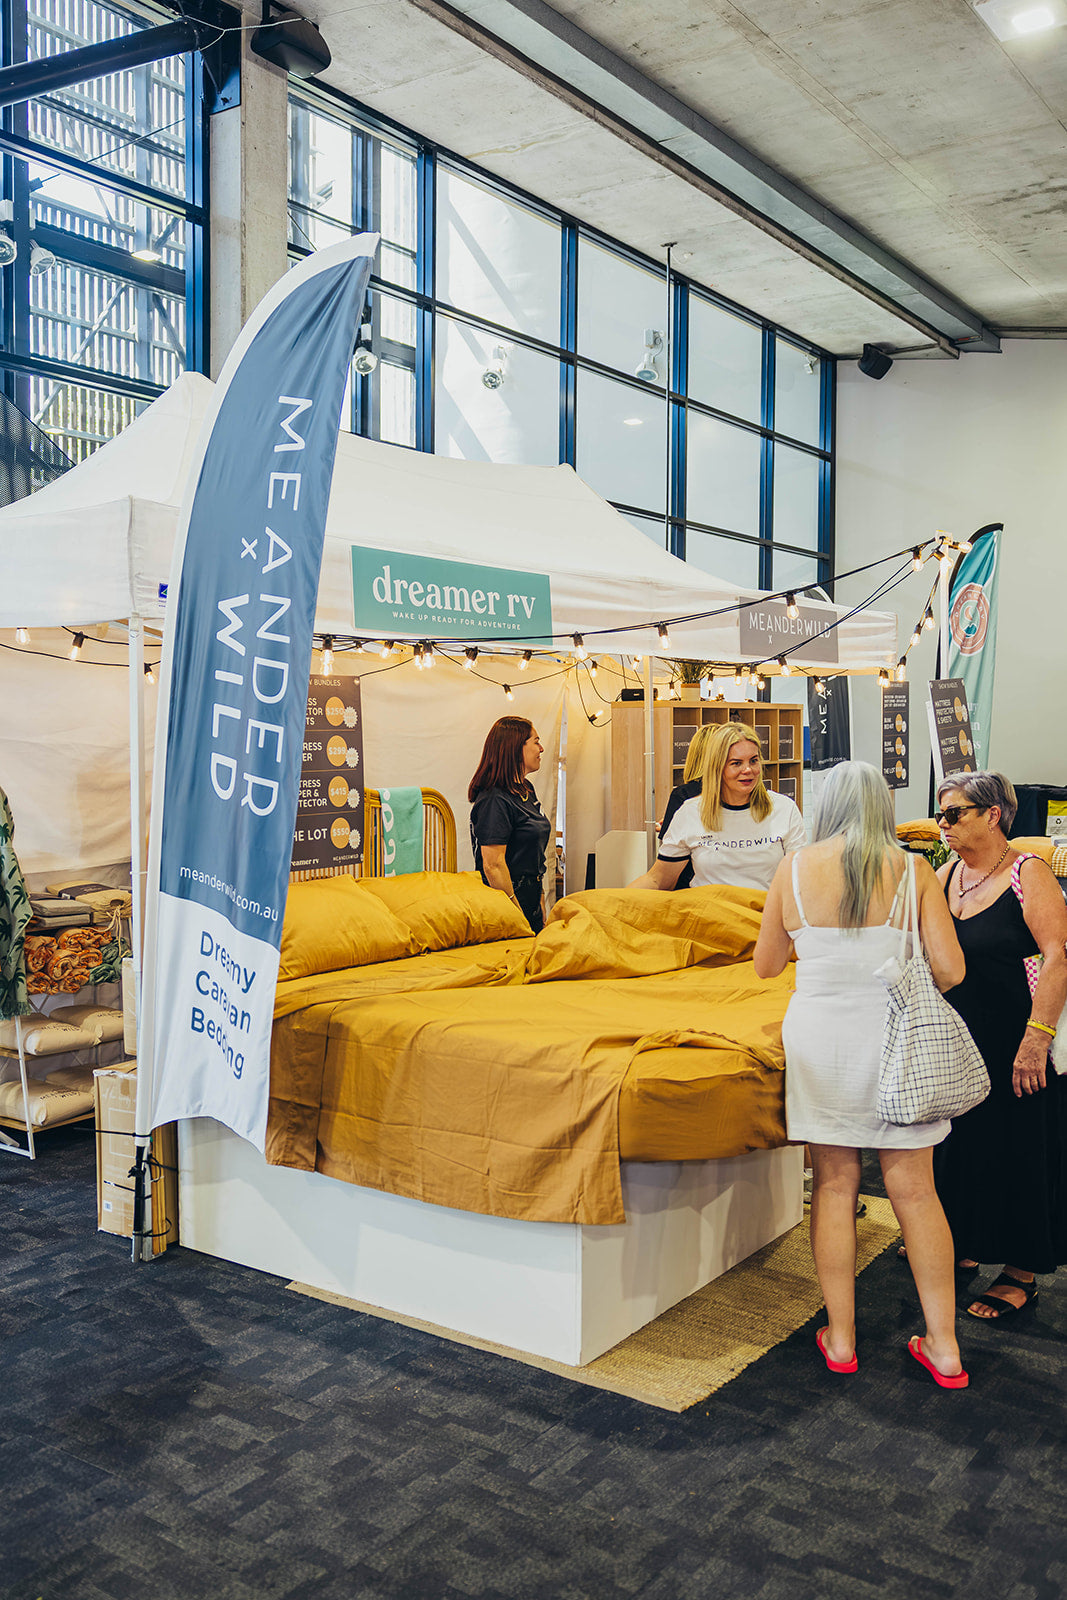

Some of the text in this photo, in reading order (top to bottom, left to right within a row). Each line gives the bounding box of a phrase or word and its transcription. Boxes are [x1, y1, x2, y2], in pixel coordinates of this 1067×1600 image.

[240, 395, 313, 817] MEANDER
[372, 565, 536, 619] dreamer rv
[392, 611, 521, 631] WAKE UP READY FOR ADVENTURE
[749, 611, 831, 638] MEANDERWILD
[210, 593, 250, 801] WILD
[313, 678, 342, 687] BUNDLES
[307, 828, 328, 841] LOT
[200, 931, 256, 994] Dreamy
